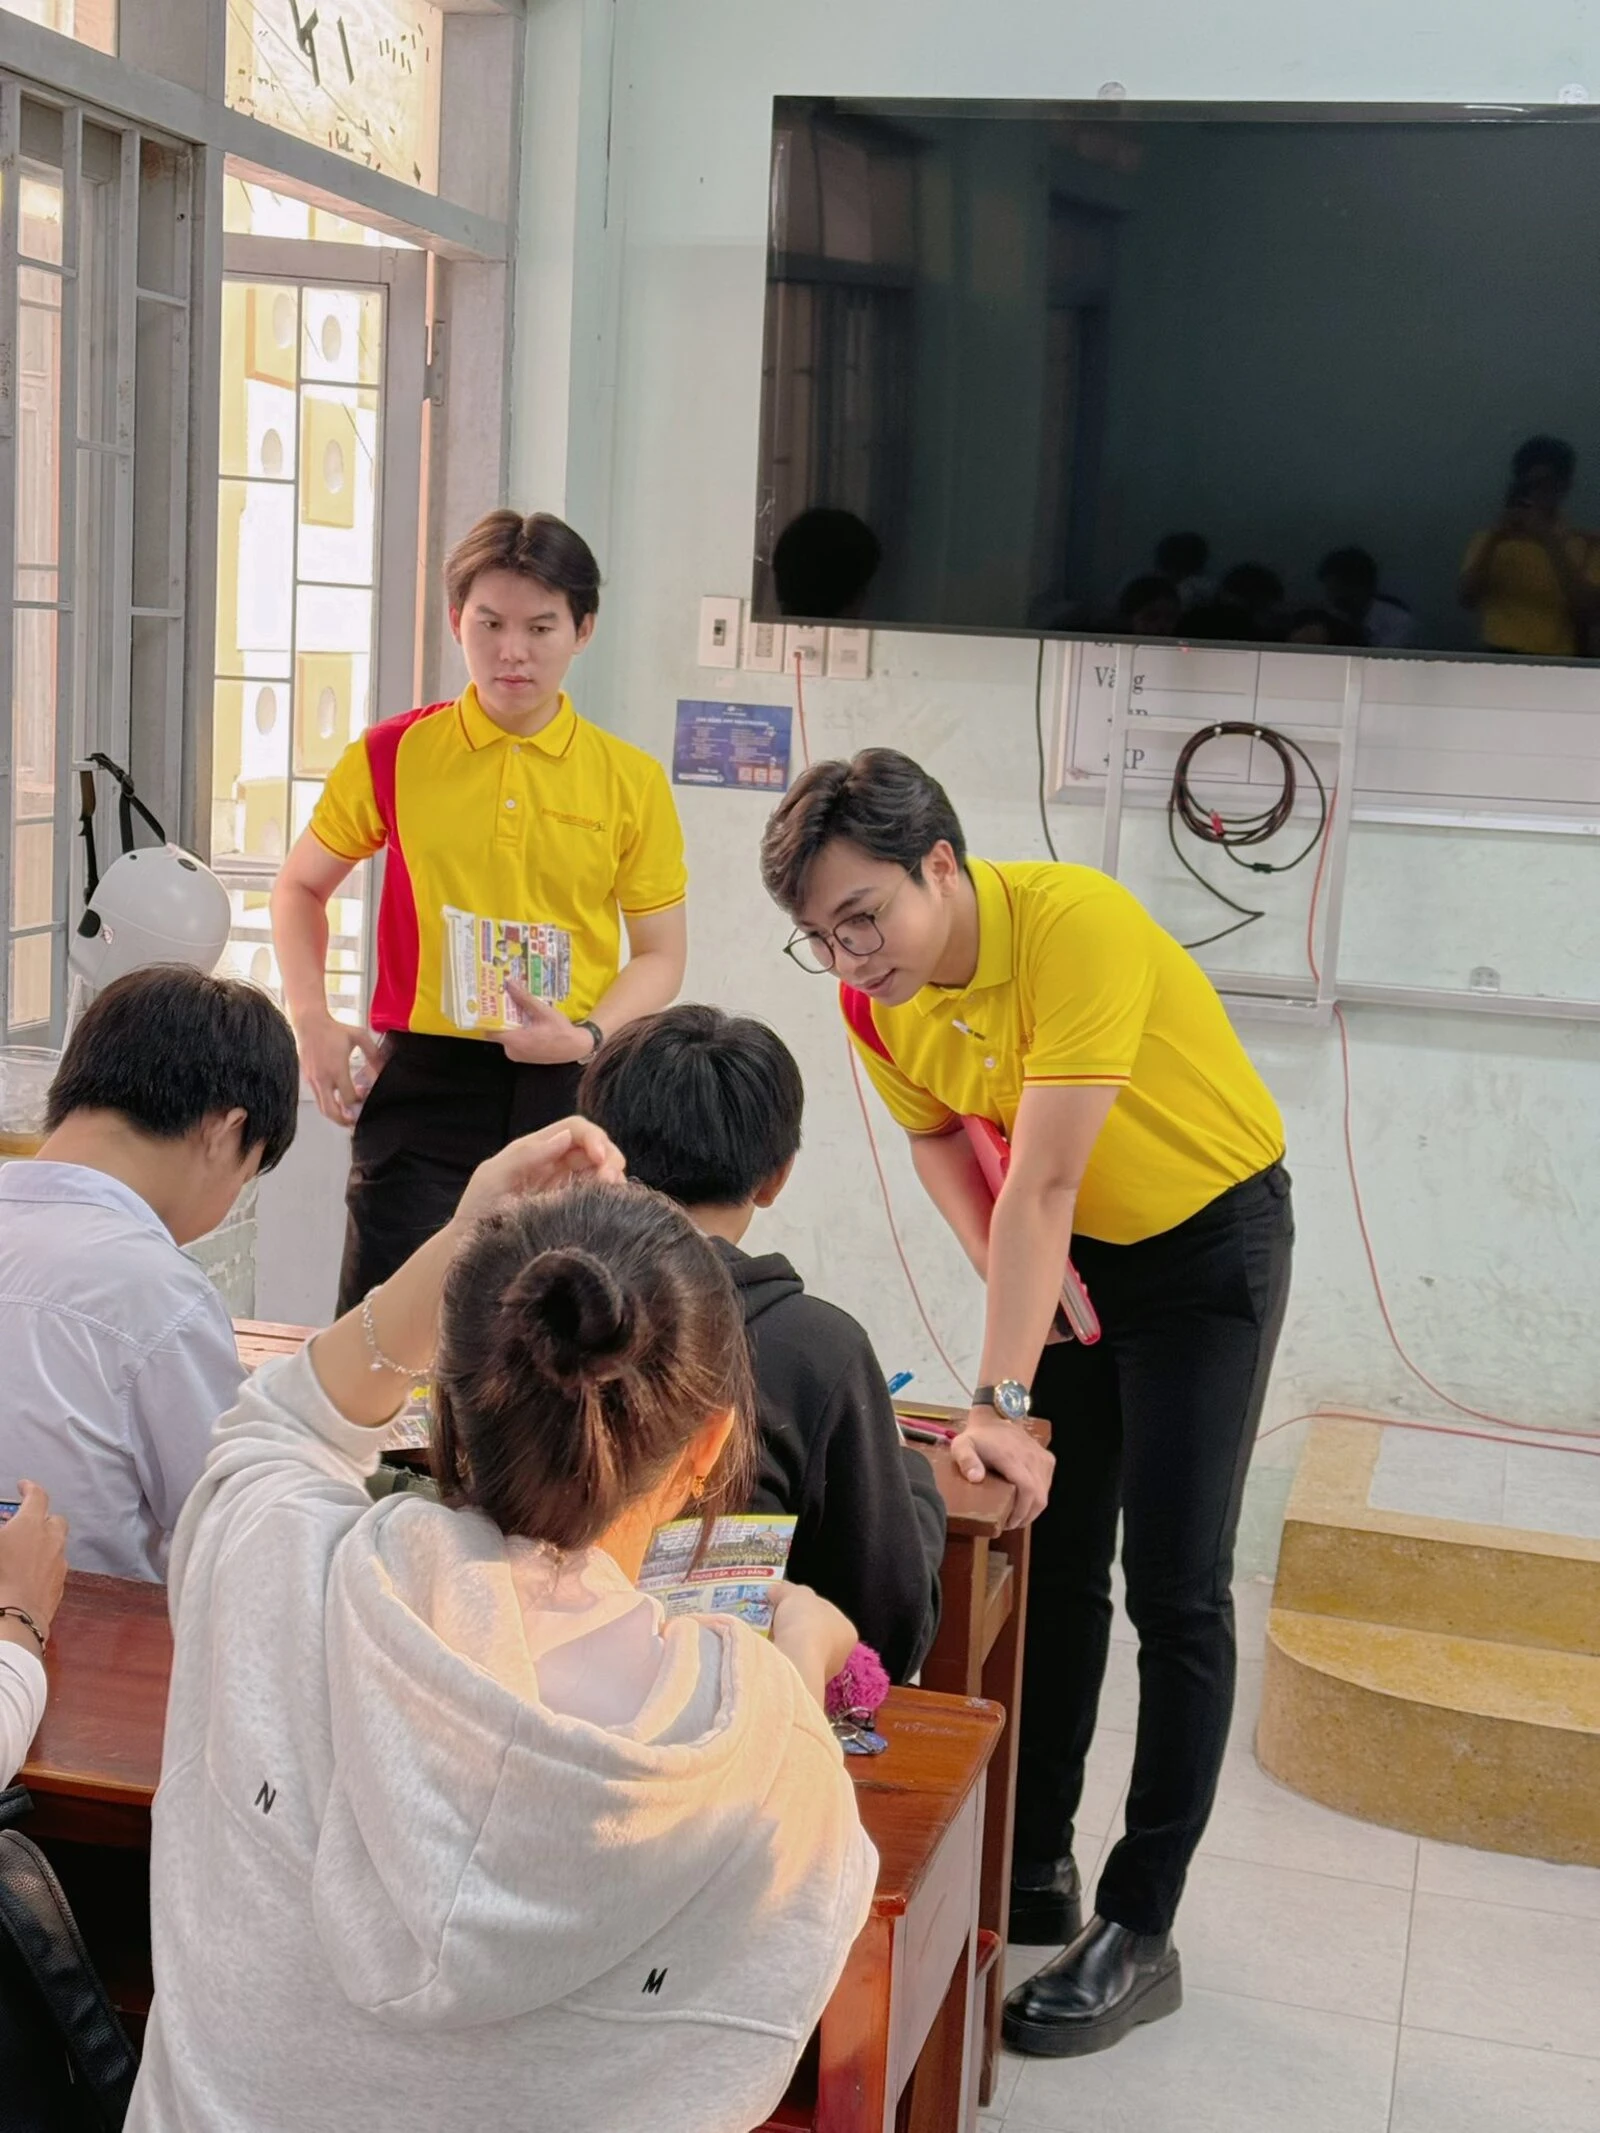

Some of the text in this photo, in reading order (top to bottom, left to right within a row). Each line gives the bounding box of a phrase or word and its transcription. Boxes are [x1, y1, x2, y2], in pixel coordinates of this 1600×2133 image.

[1094, 664, 1145, 695] Vg
[254, 1780, 277, 1814] N
[641, 1967, 669, 1996] M
